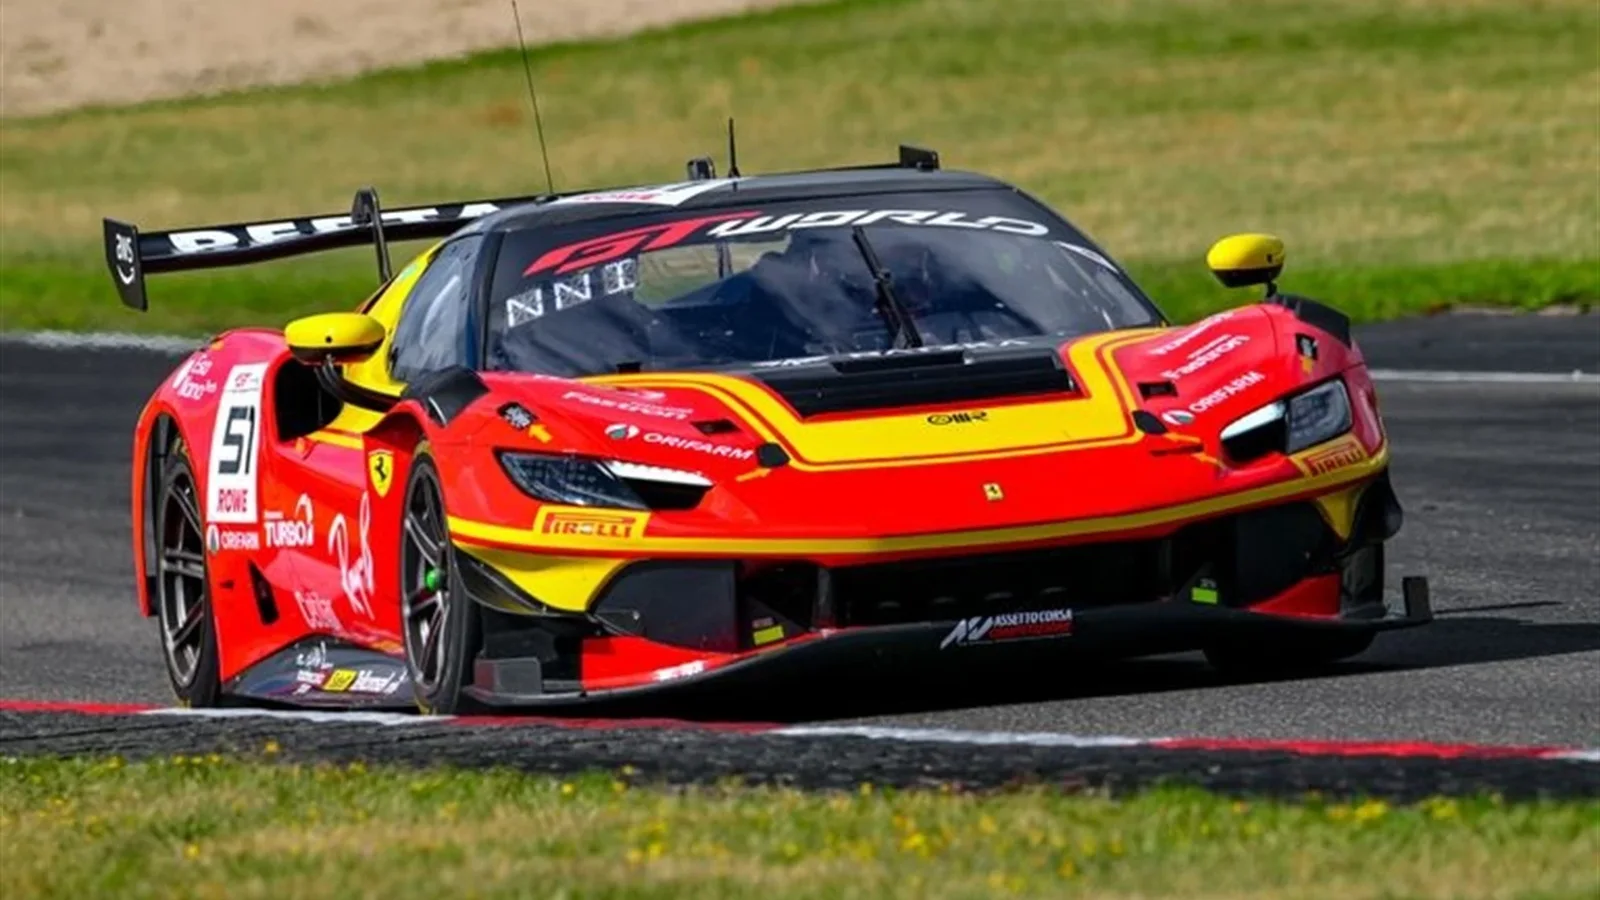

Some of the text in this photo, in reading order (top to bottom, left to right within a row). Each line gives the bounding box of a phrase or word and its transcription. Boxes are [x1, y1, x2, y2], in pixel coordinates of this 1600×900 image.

[522, 210, 1049, 277] GT WORLD
[1188, 370, 1265, 413] ORIFARM
[217, 405, 256, 475] 51
[643, 431, 753, 460] ORIFARM
[1304, 441, 1364, 478] PIRELLI
[216, 488, 248, 513] ROWE
